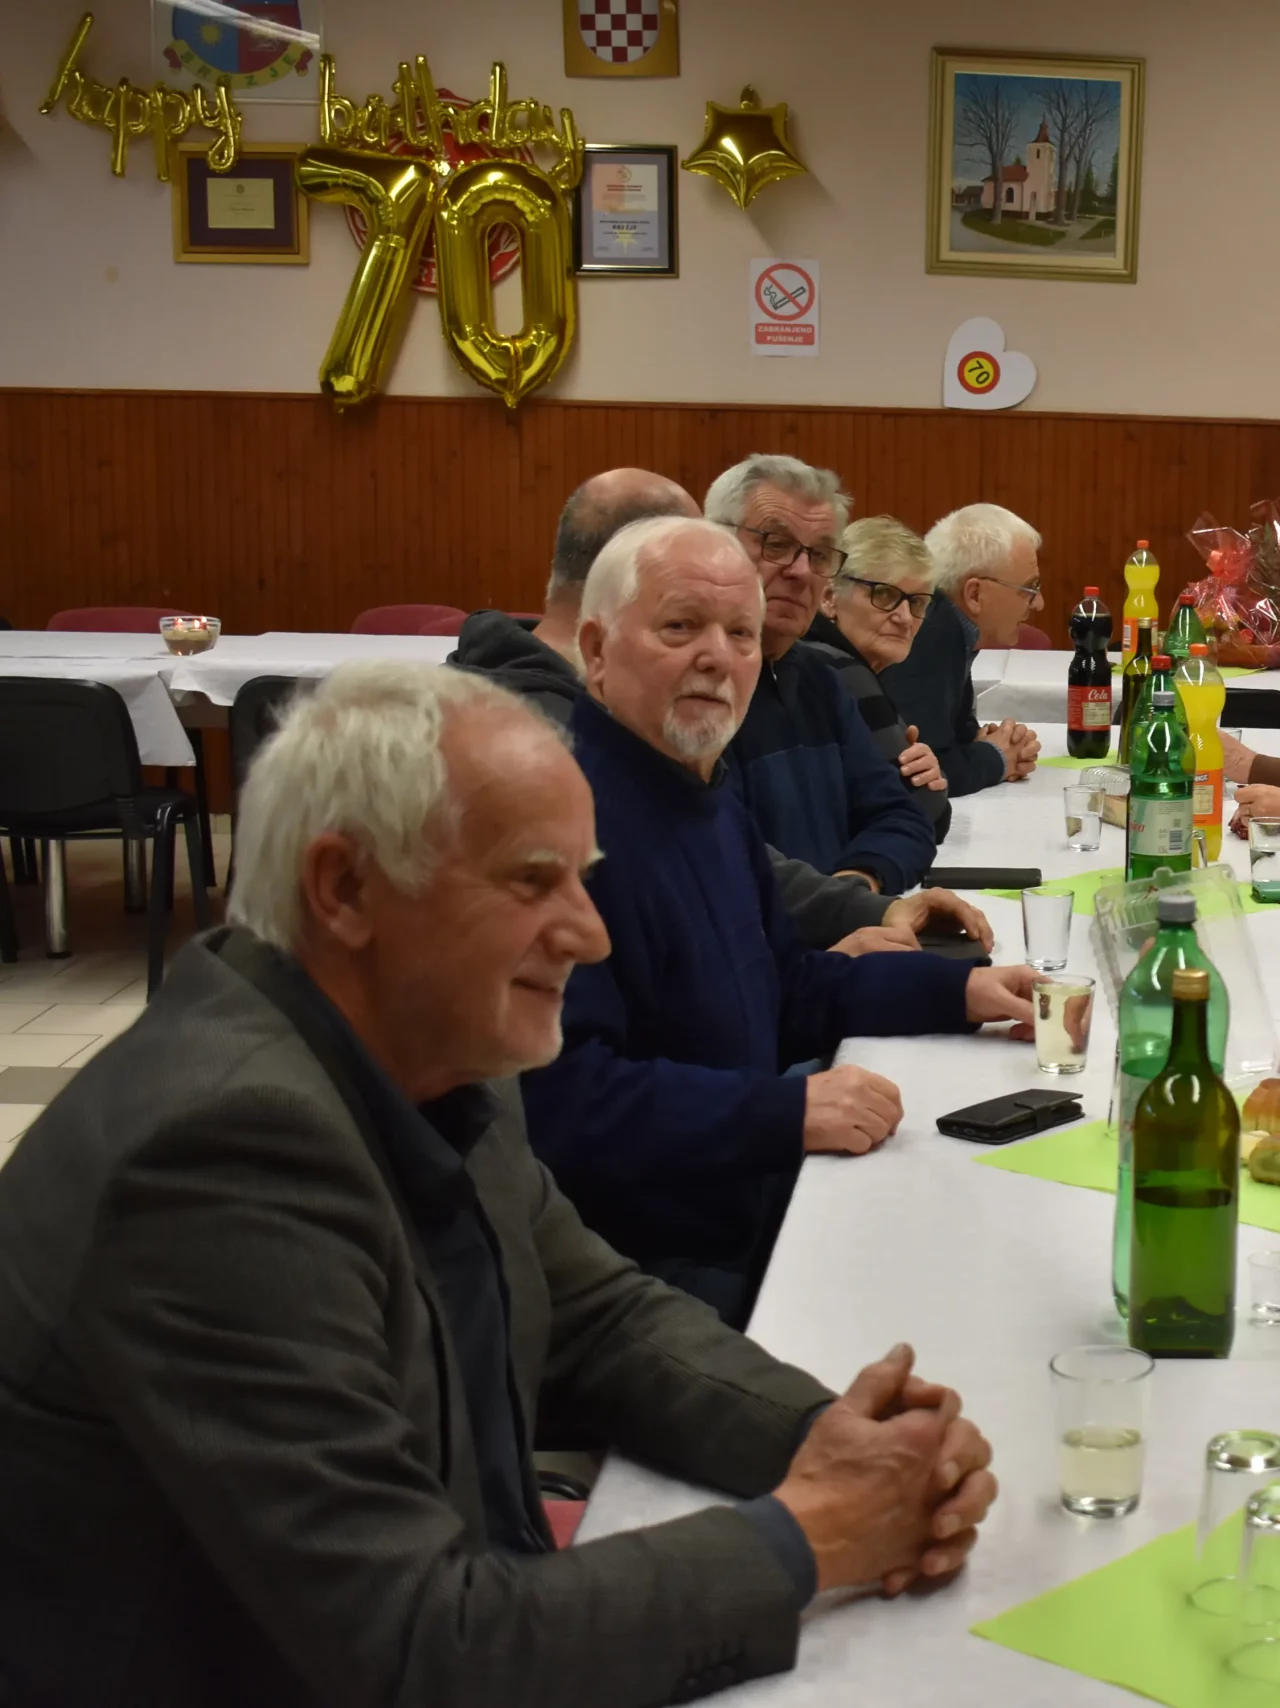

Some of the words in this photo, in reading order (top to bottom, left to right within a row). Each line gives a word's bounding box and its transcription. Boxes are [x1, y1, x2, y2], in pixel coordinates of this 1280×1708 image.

[180, 50, 297, 87] BRZJE
[39, 12, 243, 182] happy
[319, 54, 585, 189] birthday
[294, 145, 577, 408] 70
[758, 325, 812, 334] ZABRANJENO
[967, 360, 991, 385] 70
[1088, 689, 1108, 701] Cola
